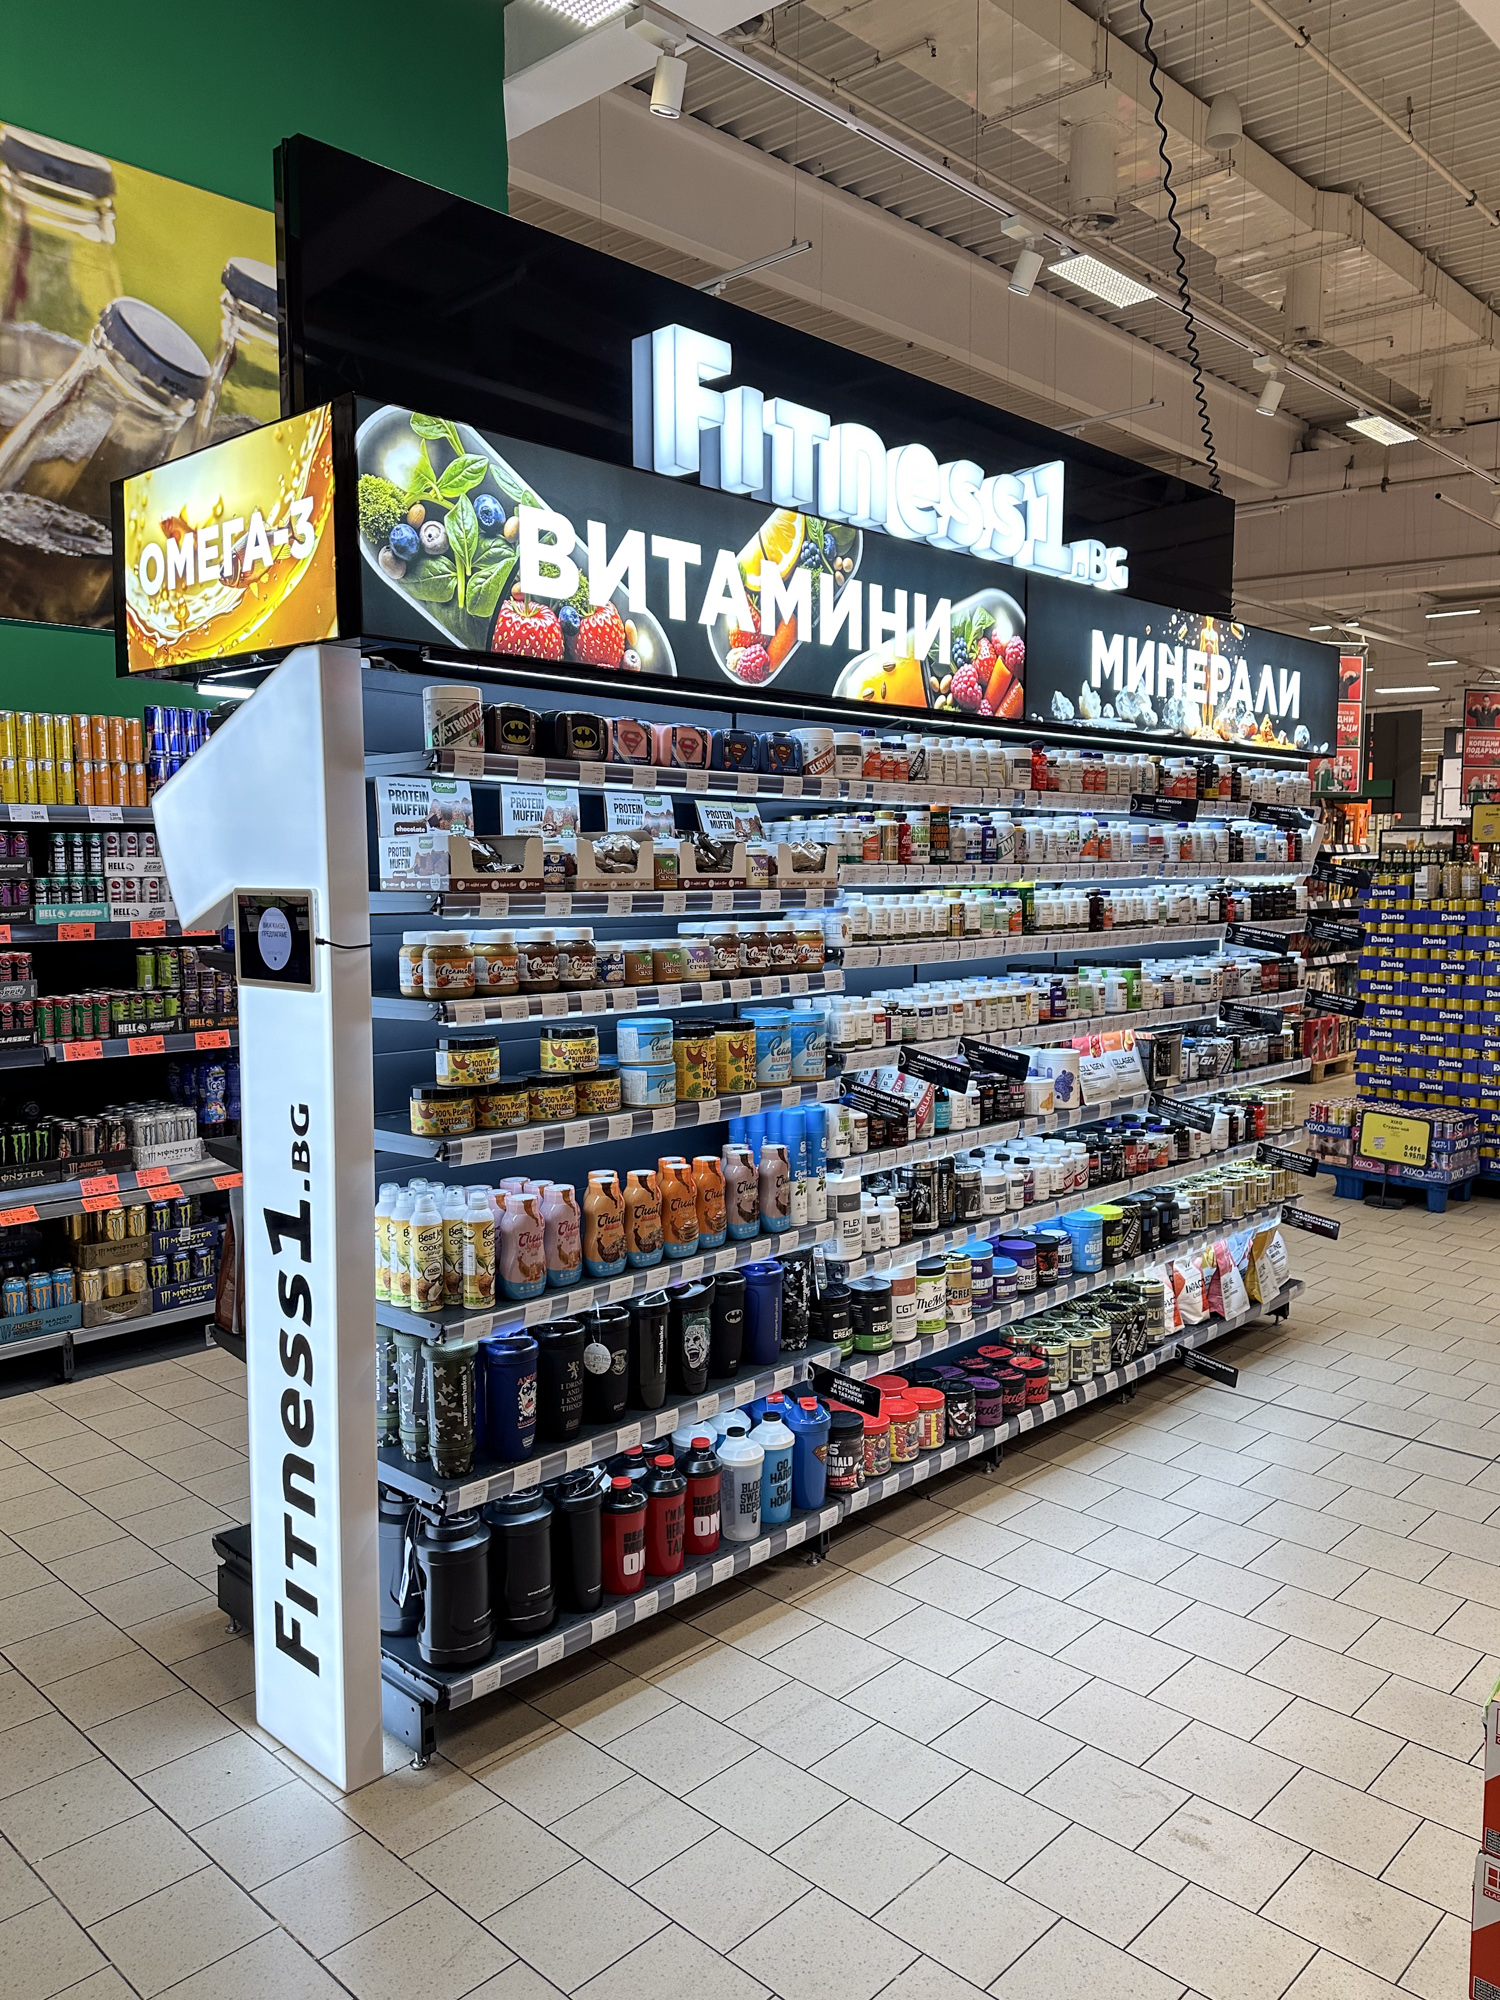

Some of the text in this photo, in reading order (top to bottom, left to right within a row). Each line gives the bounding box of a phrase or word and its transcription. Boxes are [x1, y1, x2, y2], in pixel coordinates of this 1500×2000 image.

[138, 496, 316, 596] ОМЕГА-3
[518, 504, 951, 665] ВИТАМИНИ
[1091, 628, 1301, 720] МИНЕРАЛИ
[395, 825, 426, 833] chocolate
[107, 862, 125, 870] HELL
[1372, 888, 1396, 896] Dante
[38, 909, 57, 918] HELL
[113, 908, 130, 916] HELL
[1381, 912, 1404, 920] Dante
[1441, 913, 1466, 921] Dante
[1371, 935, 1394, 944] Dante
[1422, 937, 1446, 945] Dante
[1380, 960, 1404, 968] Dante
[1440, 962, 1465, 970] Dante
[1370, 982, 1393, 990] Dante
[1422, 986, 1446, 994] Dante
[1380, 1008, 1402, 1016] Dante
[1439, 1012, 1464, 1020] Dante
[61, 1009, 72, 1035] HELL
[189, 1018, 205, 1027] HELL
[118, 1023, 137, 1034] HELL
[1370, 1029, 1392, 1038] Dante
[1420, 1034, 1444, 1042] Dante
[978, 1044, 1019, 1061] ХРАНОСМИЛАНЕ
[1379, 1054, 1402, 1062] Dante
[917, 1054, 961, 1073] АНТИОКСИДАНТИ
[1438, 1060, 1462, 1068] Dante
[1368, 1076, 1392, 1085] Dante
[1419, 1082, 1443, 1090] Dante
[851, 1085, 890, 1103] ЗДРАВОСЛОВНИ
[890, 1097, 909, 1108] ХРАНИ
[1305, 1122, 1326, 1132] XIXO
[1354, 1160, 1374, 1169] XIXO
[1402, 1166, 1425, 1178] XIXO
[671, 1198, 695, 1212] Cheat
[634, 1205, 660, 1220] Cheat
[598, 1212, 622, 1228] Cheat
[843, 1219, 860, 1228] FLEX
[896, 1303, 914, 1314] CGT
[45, 1314, 73, 1325] MANGO
[48, 1319, 70, 1327] LOCO
[566, 1388, 580, 1396] AND
[560, 1403, 583, 1413] THINGS
[776, 1459, 788, 1472] GO
[770, 1467, 792, 1484] HARD
[827, 1467, 846, 1476] UMP
[776, 1482, 788, 1496] GO
